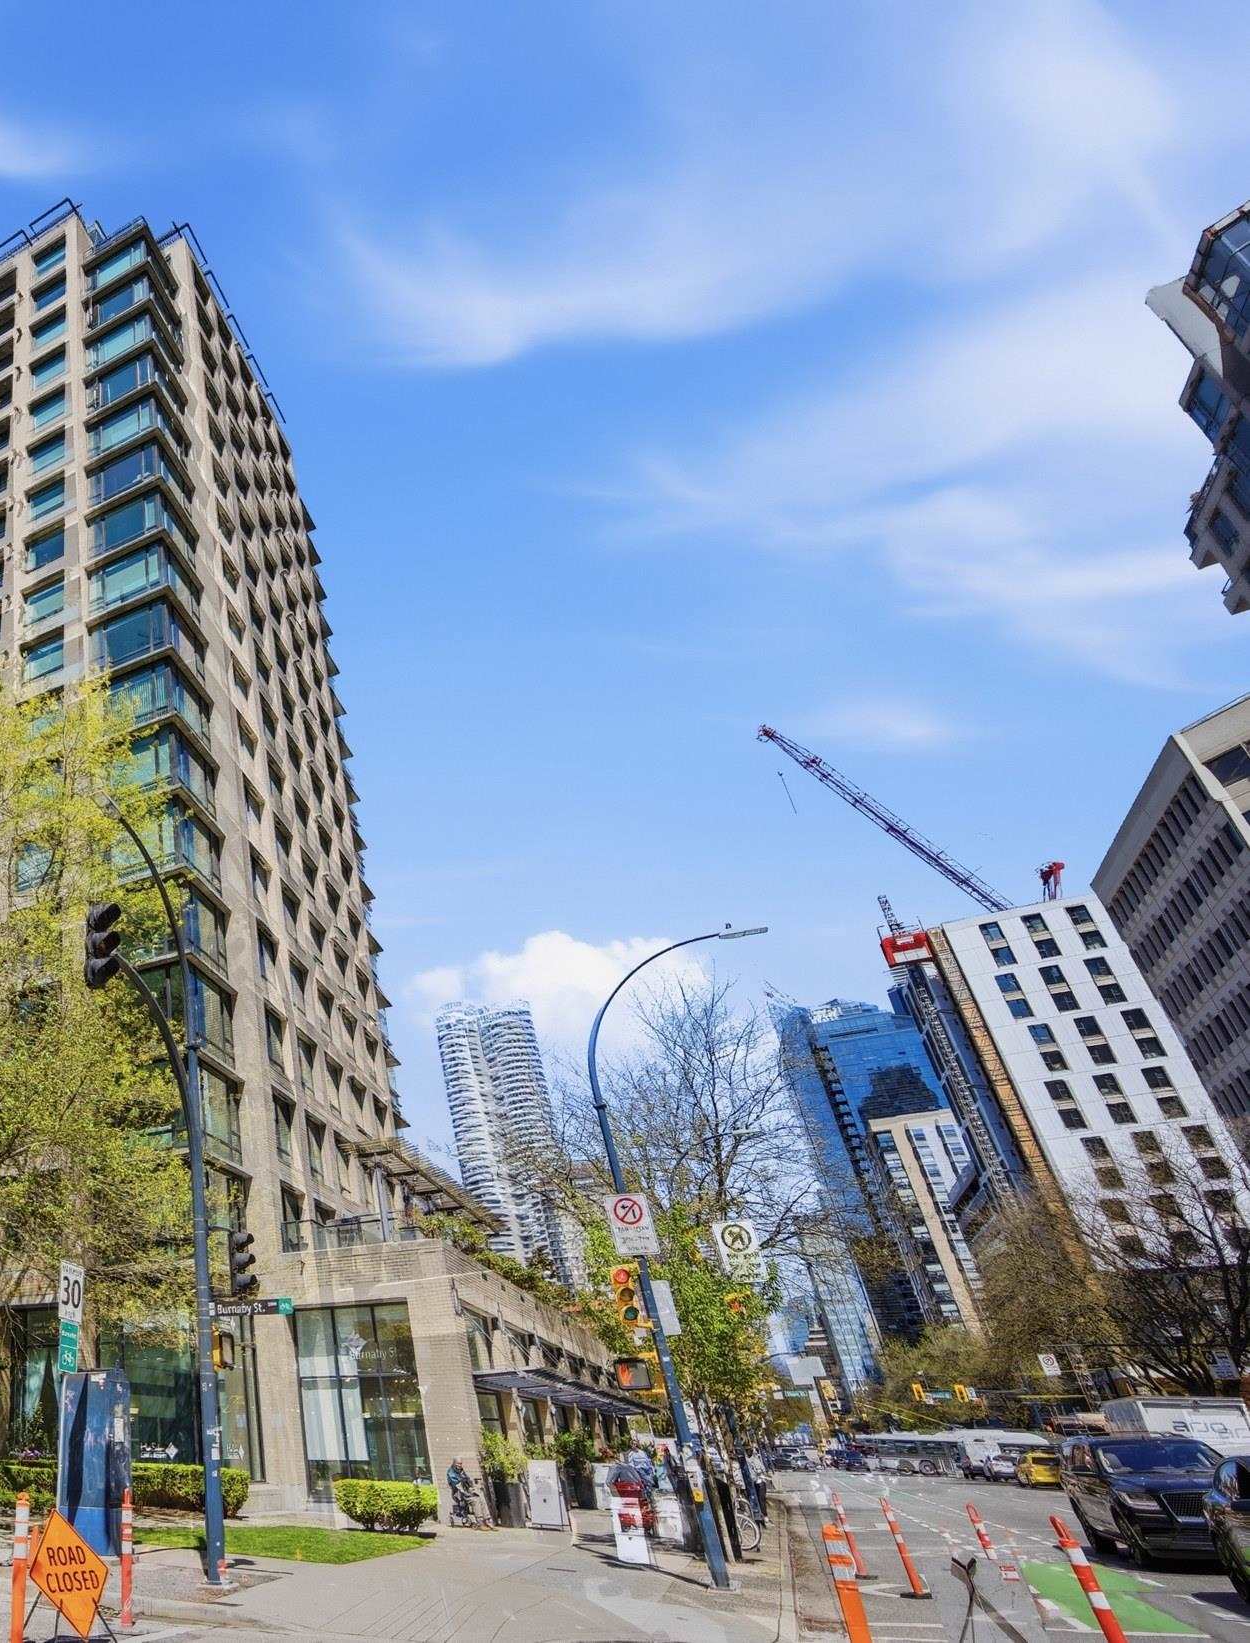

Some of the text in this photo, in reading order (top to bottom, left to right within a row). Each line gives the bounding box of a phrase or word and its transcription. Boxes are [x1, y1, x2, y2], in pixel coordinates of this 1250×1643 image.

[61, 1275, 82, 1309] 30
[217, 1303, 252, 1316] Burnaby
[253, 1302, 266, 1313] St.
[46, 1545, 86, 1567] ROAD
[46, 1570, 100, 1594] CLOSED
